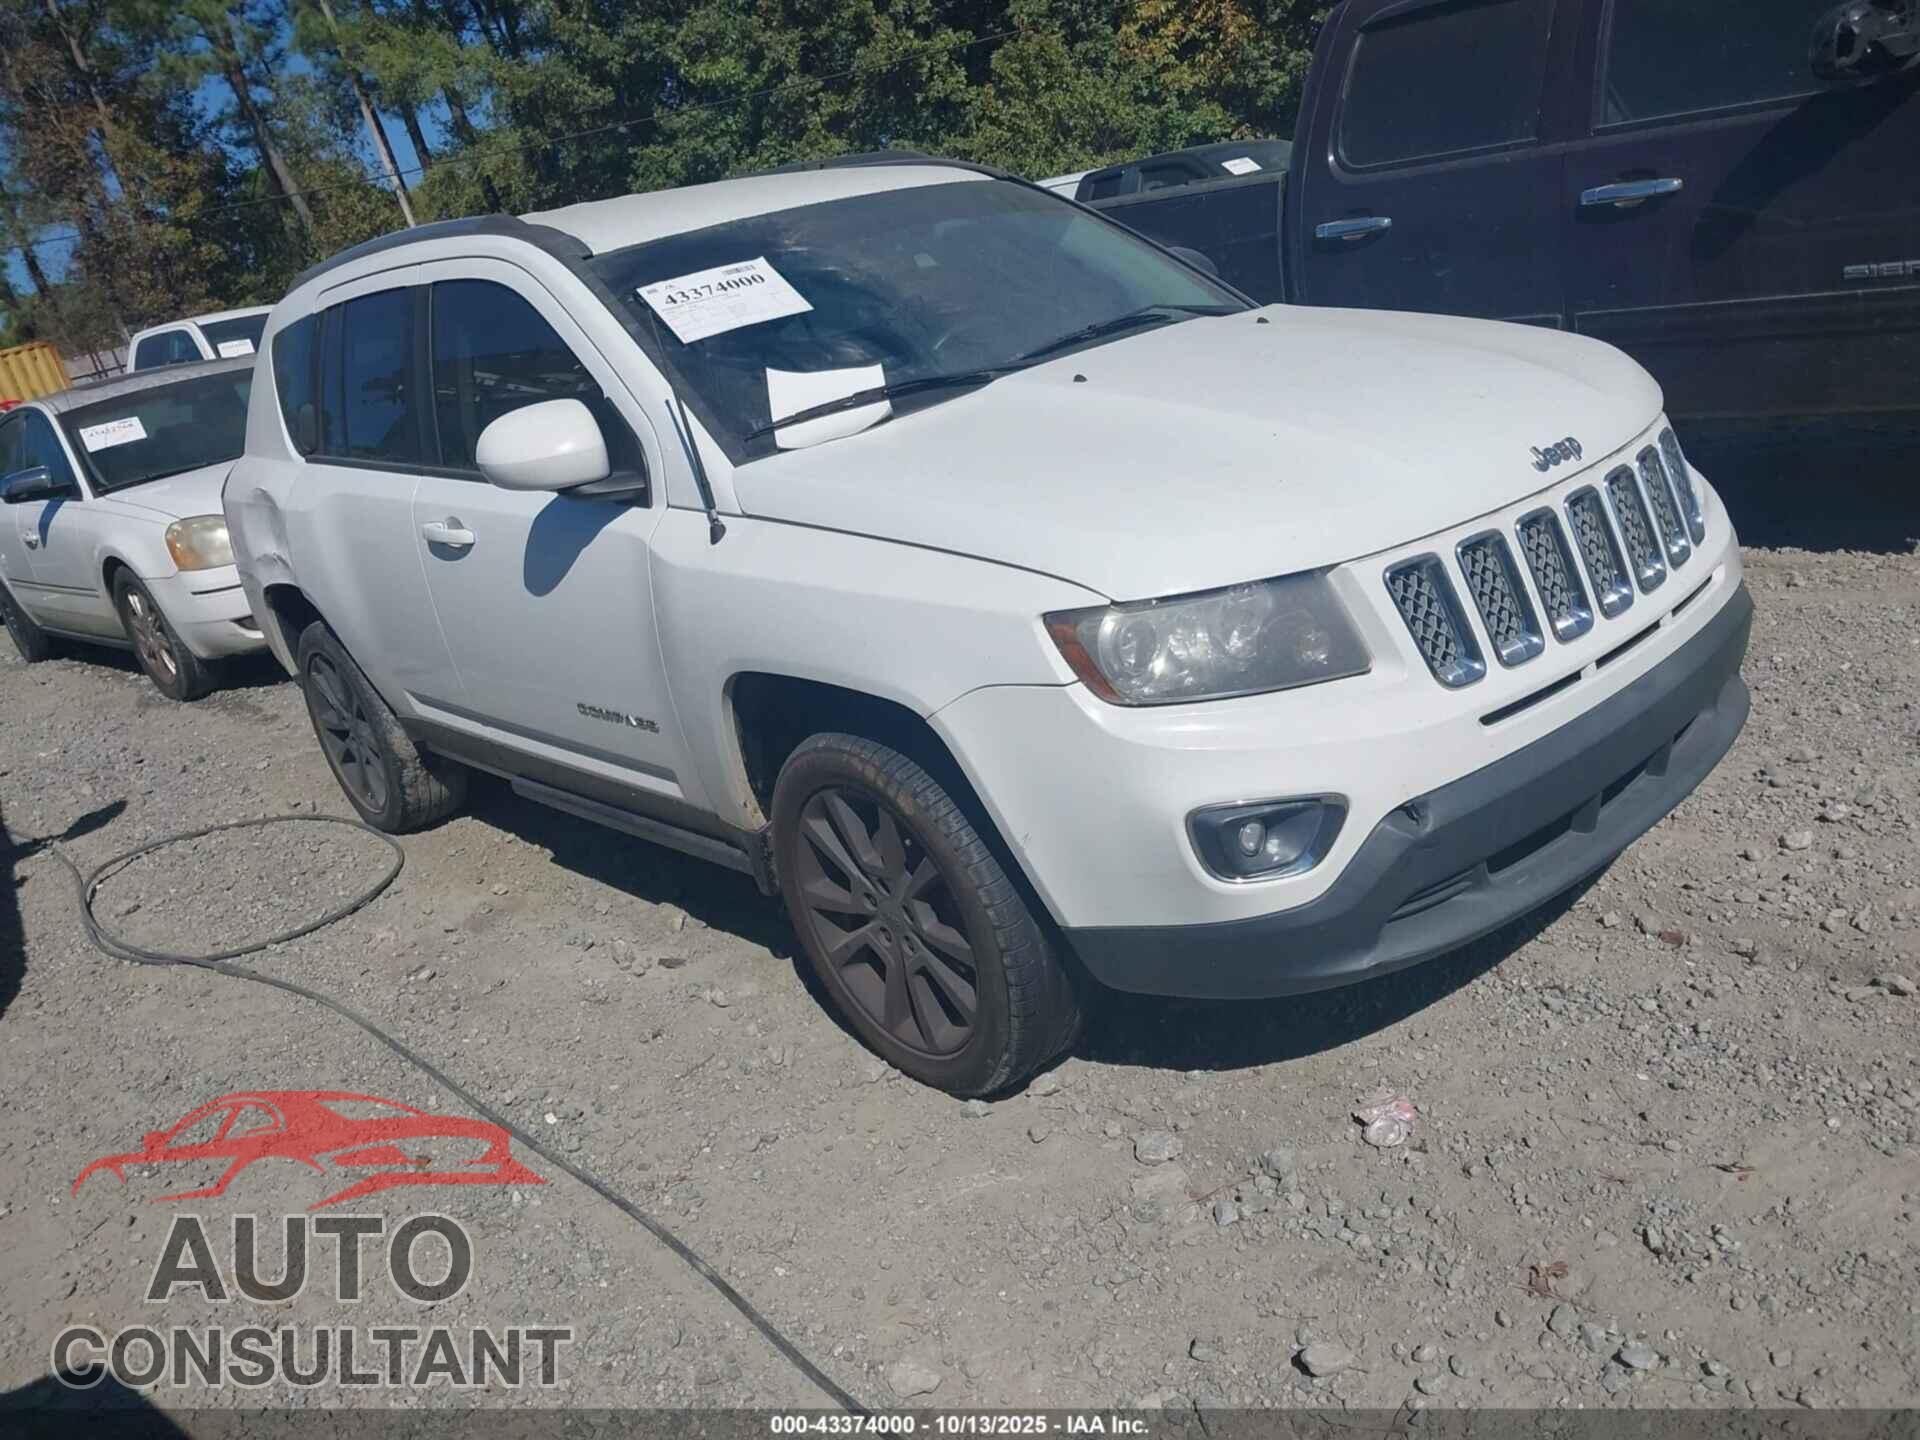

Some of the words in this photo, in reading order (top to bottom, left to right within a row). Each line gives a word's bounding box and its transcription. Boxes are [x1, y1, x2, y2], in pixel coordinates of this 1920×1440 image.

[664, 273, 766, 305] 43374000
[1529, 436, 1582, 473] Jeep
[576, 702, 660, 734] COMPASS
